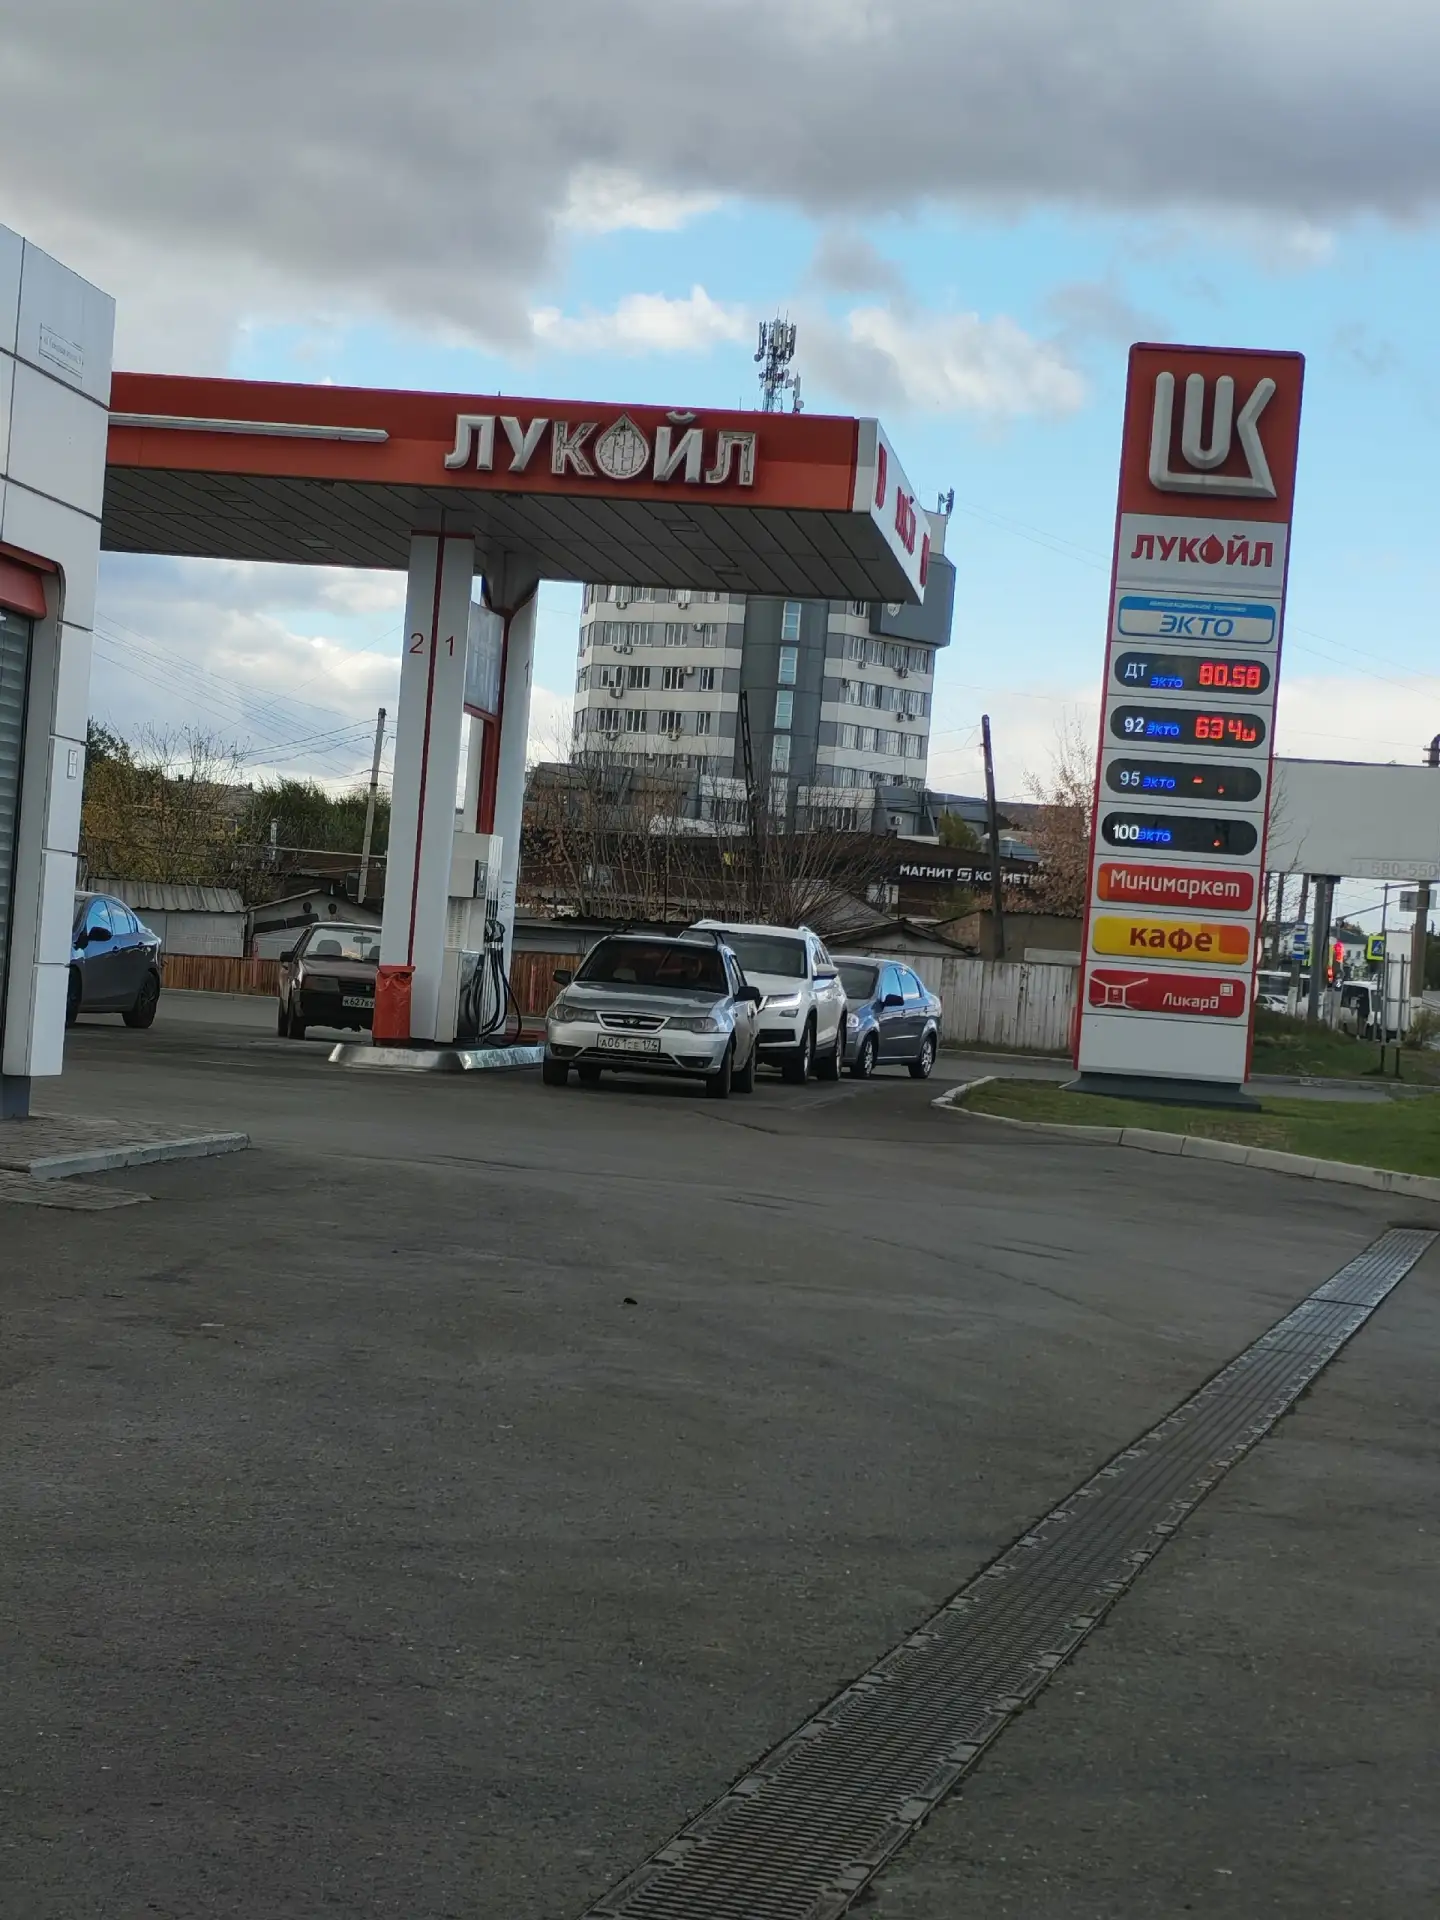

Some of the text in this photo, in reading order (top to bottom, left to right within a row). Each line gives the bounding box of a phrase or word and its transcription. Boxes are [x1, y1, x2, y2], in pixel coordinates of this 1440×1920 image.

[444, 411, 757, 486] ЛУКОЙЛ
[1131, 534, 1274, 567] ЛУКОЙЛ
[1159, 614, 1234, 637] ЭКТО
[409, 632, 424, 654] 2
[445, 635, 454, 656] 1
[1124, 663, 1148, 679] ДТ
[1150, 675, 1184, 688] ЭКТО
[1124, 716, 1145, 733] 92
[1146, 721, 1180, 736] ЭКТО
[1120, 771, 1176, 789] 95 ЭКТО
[1112, 824, 1171, 842] 100 ЭКТО
[900, 865, 954, 878] МАГНИТ
[1110, 869, 1240, 899] Минимаркет
[1130, 927, 1213, 952] кафе
[1162, 992, 1219, 1011] Ликард
